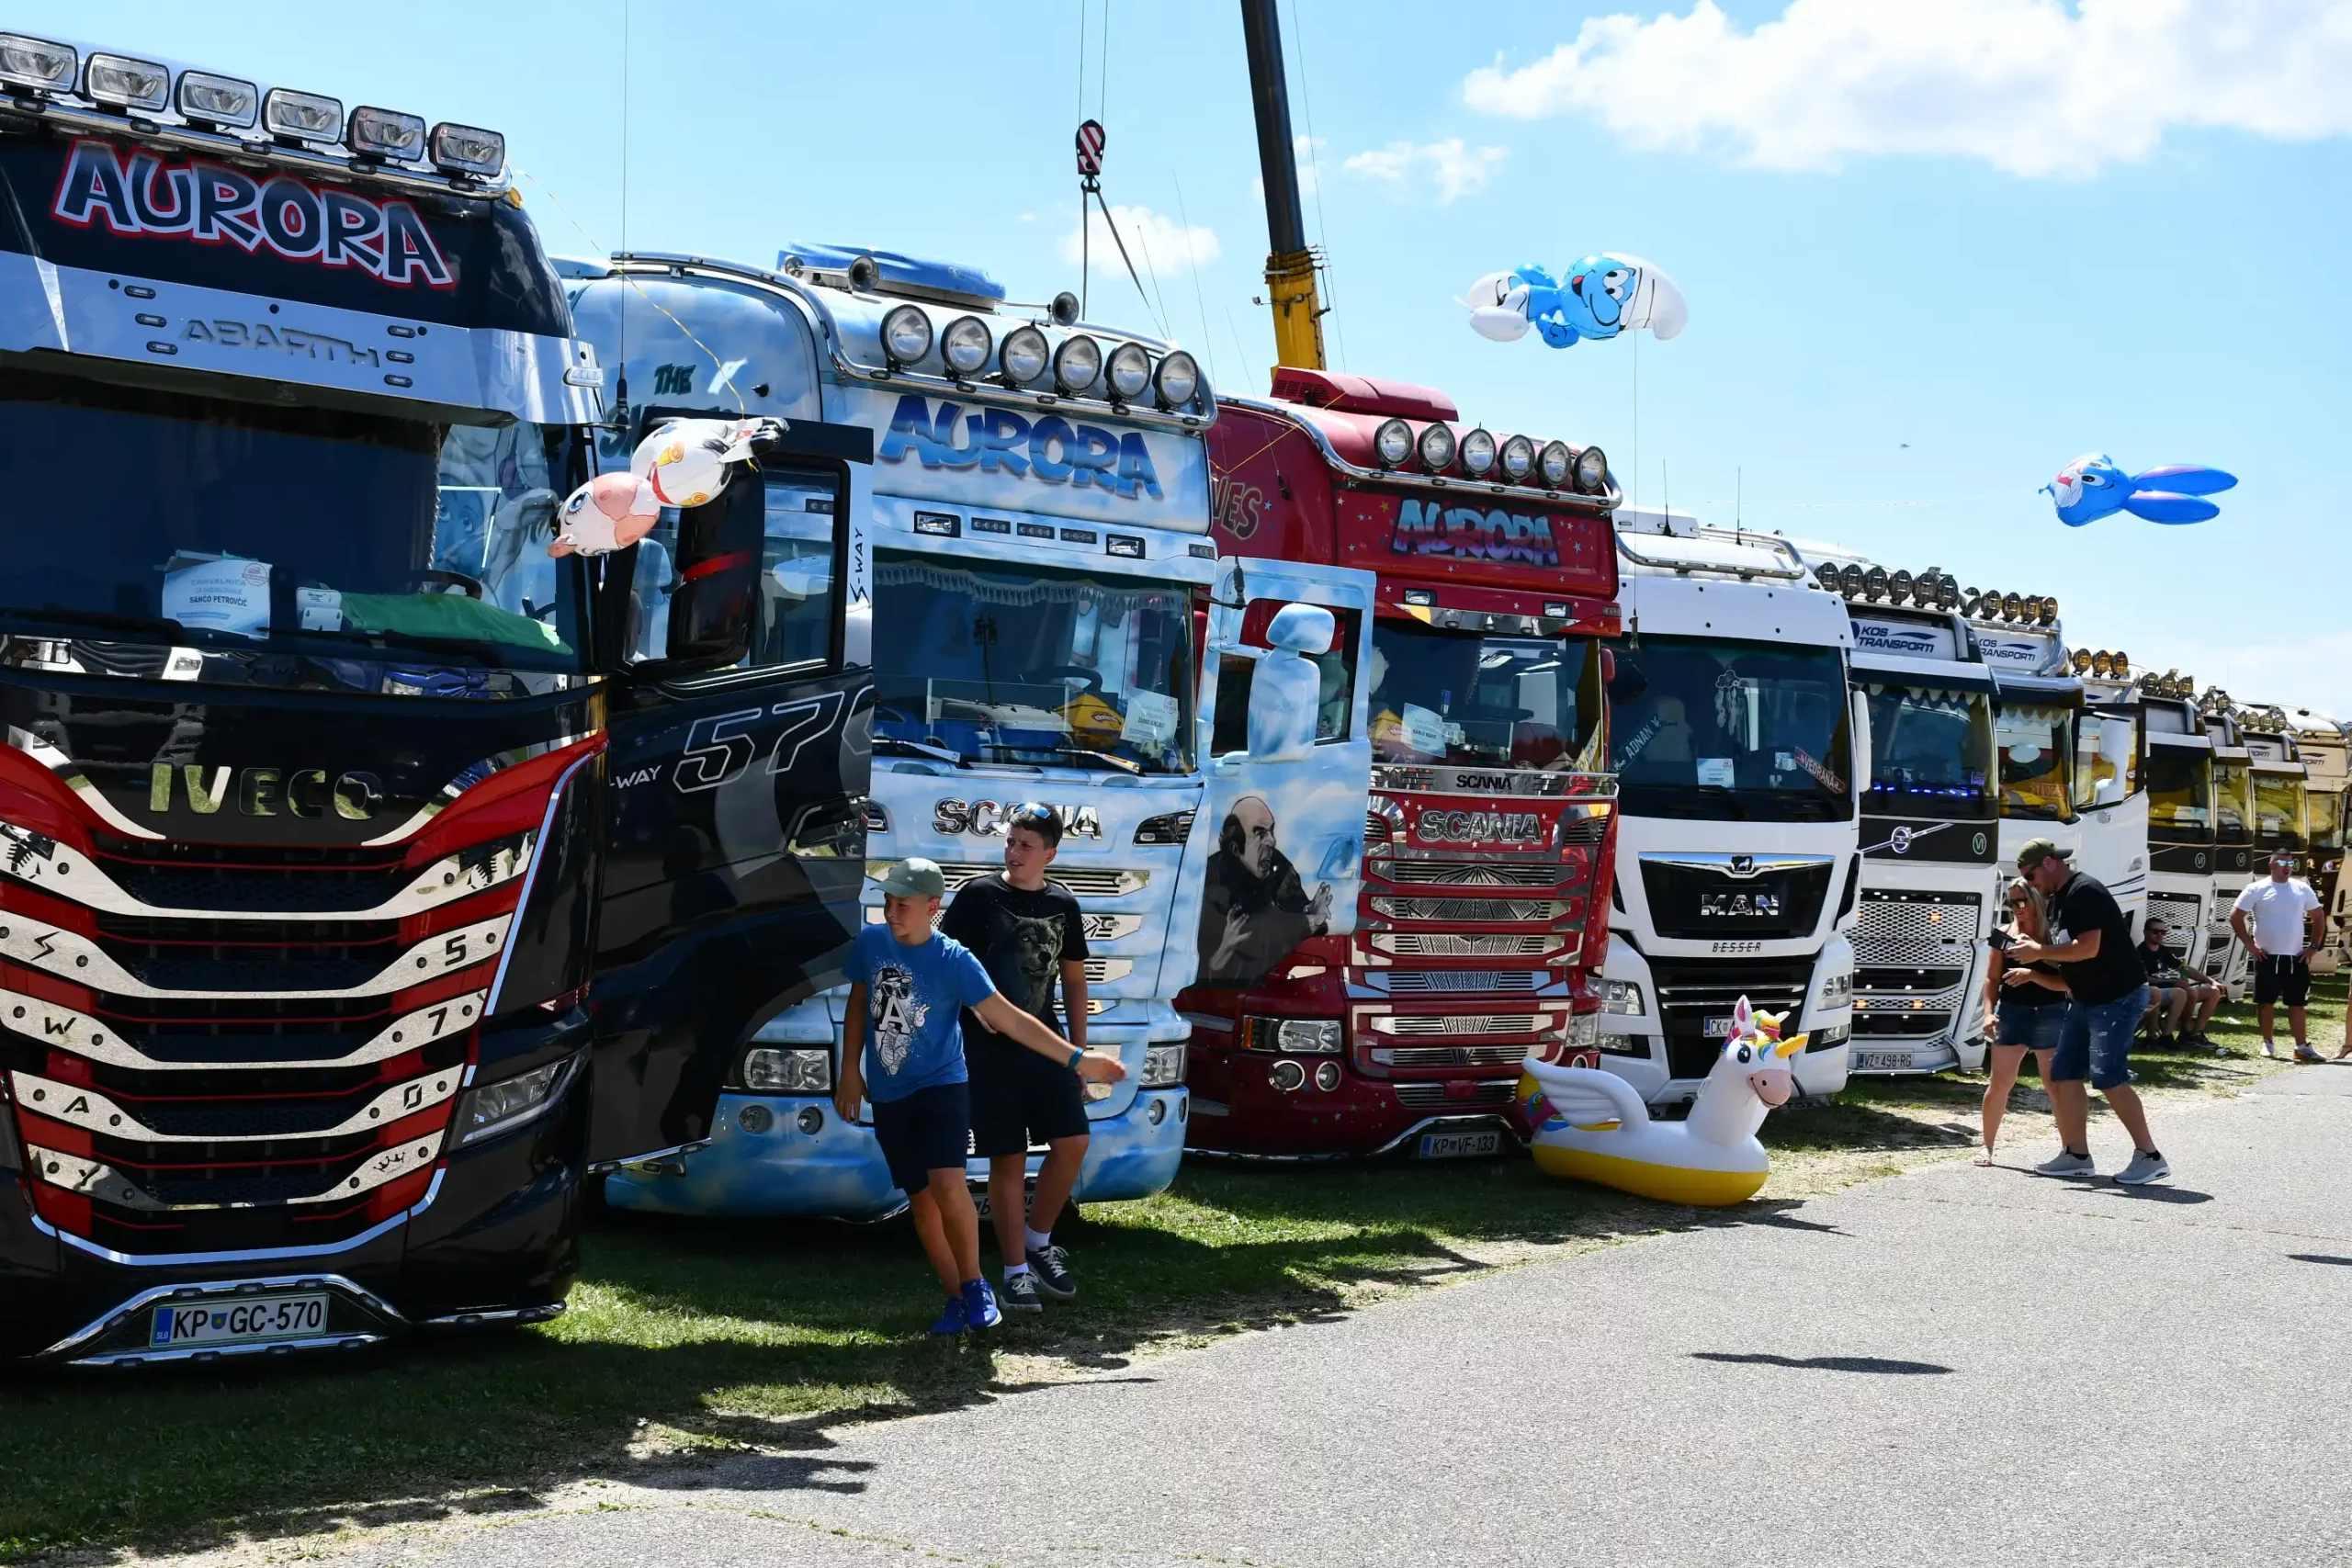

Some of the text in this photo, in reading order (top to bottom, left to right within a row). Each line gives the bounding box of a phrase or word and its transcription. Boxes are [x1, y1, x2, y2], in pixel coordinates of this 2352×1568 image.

[53, 138, 458, 289] AURORA
[180, 319, 379, 368] ABARTH
[654, 363, 696, 395] THE
[878, 394, 1166, 499] AURORA
[1392, 498, 1559, 567] AURORA
[850, 527, 872, 608] S-WAY
[1859, 637, 1934, 653] TRANSPORTI
[1861, 626, 1888, 637] KOS
[1980, 649, 2035, 662] RANSPORTI
[1624, 724, 1654, 759] ADNAN
[609, 765, 662, 789] -WAY
[1456, 774, 1512, 790] SCANIA
[1804, 755, 1835, 790] VEDRANA
[150, 761, 383, 820] IVECO
[933, 797, 1102, 840] SCIA
[1417, 809, 1543, 845] SCANIA
[1701, 894, 1780, 916] MAN
[1712, 942, 1761, 953] BESSER
[878, 993, 910, 1034] A
[1711, 1020, 1723, 1034] CK
[1431, 1138, 1449, 1155] KP
[173, 1309, 209, 1339] KP
[230, 1300, 322, 1335] GC-570
